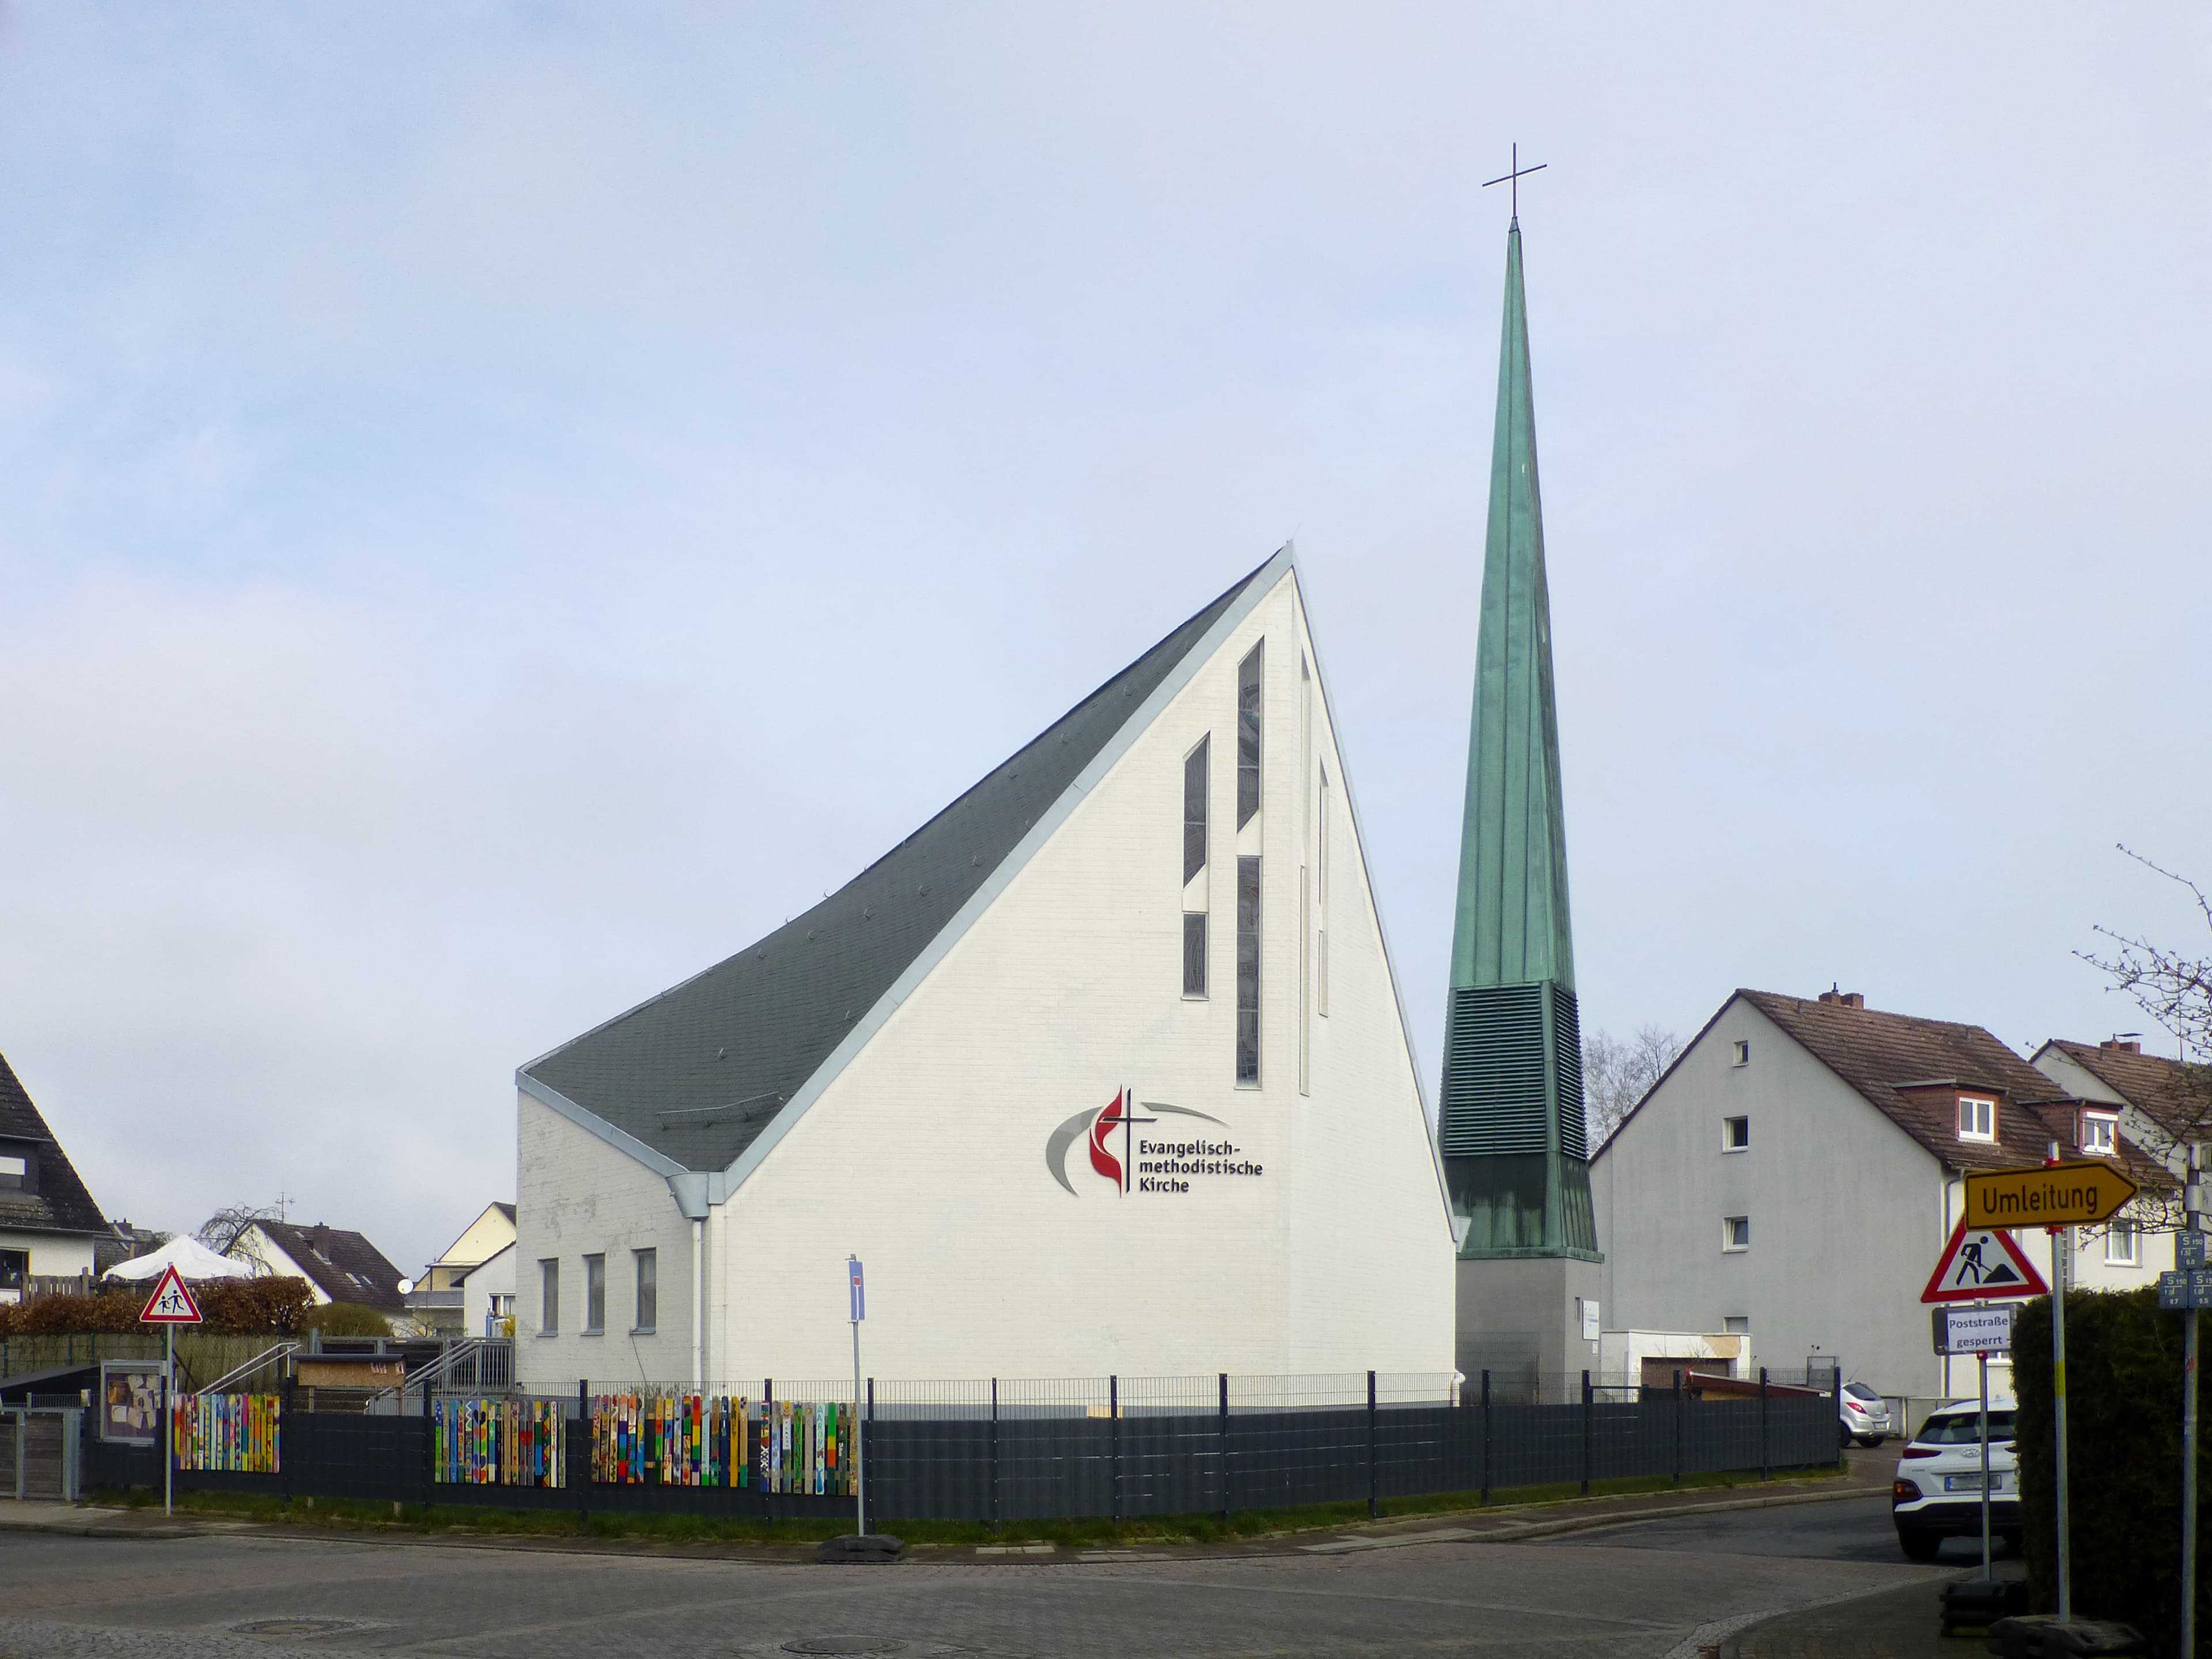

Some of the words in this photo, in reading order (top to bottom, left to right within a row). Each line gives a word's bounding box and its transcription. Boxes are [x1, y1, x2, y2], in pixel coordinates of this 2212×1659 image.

[1139, 1140, 1240, 1157] Evangelisch-
[1139, 1159, 1263, 1176] methodistische
[1139, 1177, 1190, 1192] Kirche
[1983, 1183, 2097, 1215] Umleitung
[2183, 1236, 2190, 1245] S
[2166, 1276, 2174, 1285] S
[2196, 1275, 2203, 1284] S
[1949, 1316, 2008, 1328] Poststraße
[1957, 1336, 2003, 1349] gesperrt
